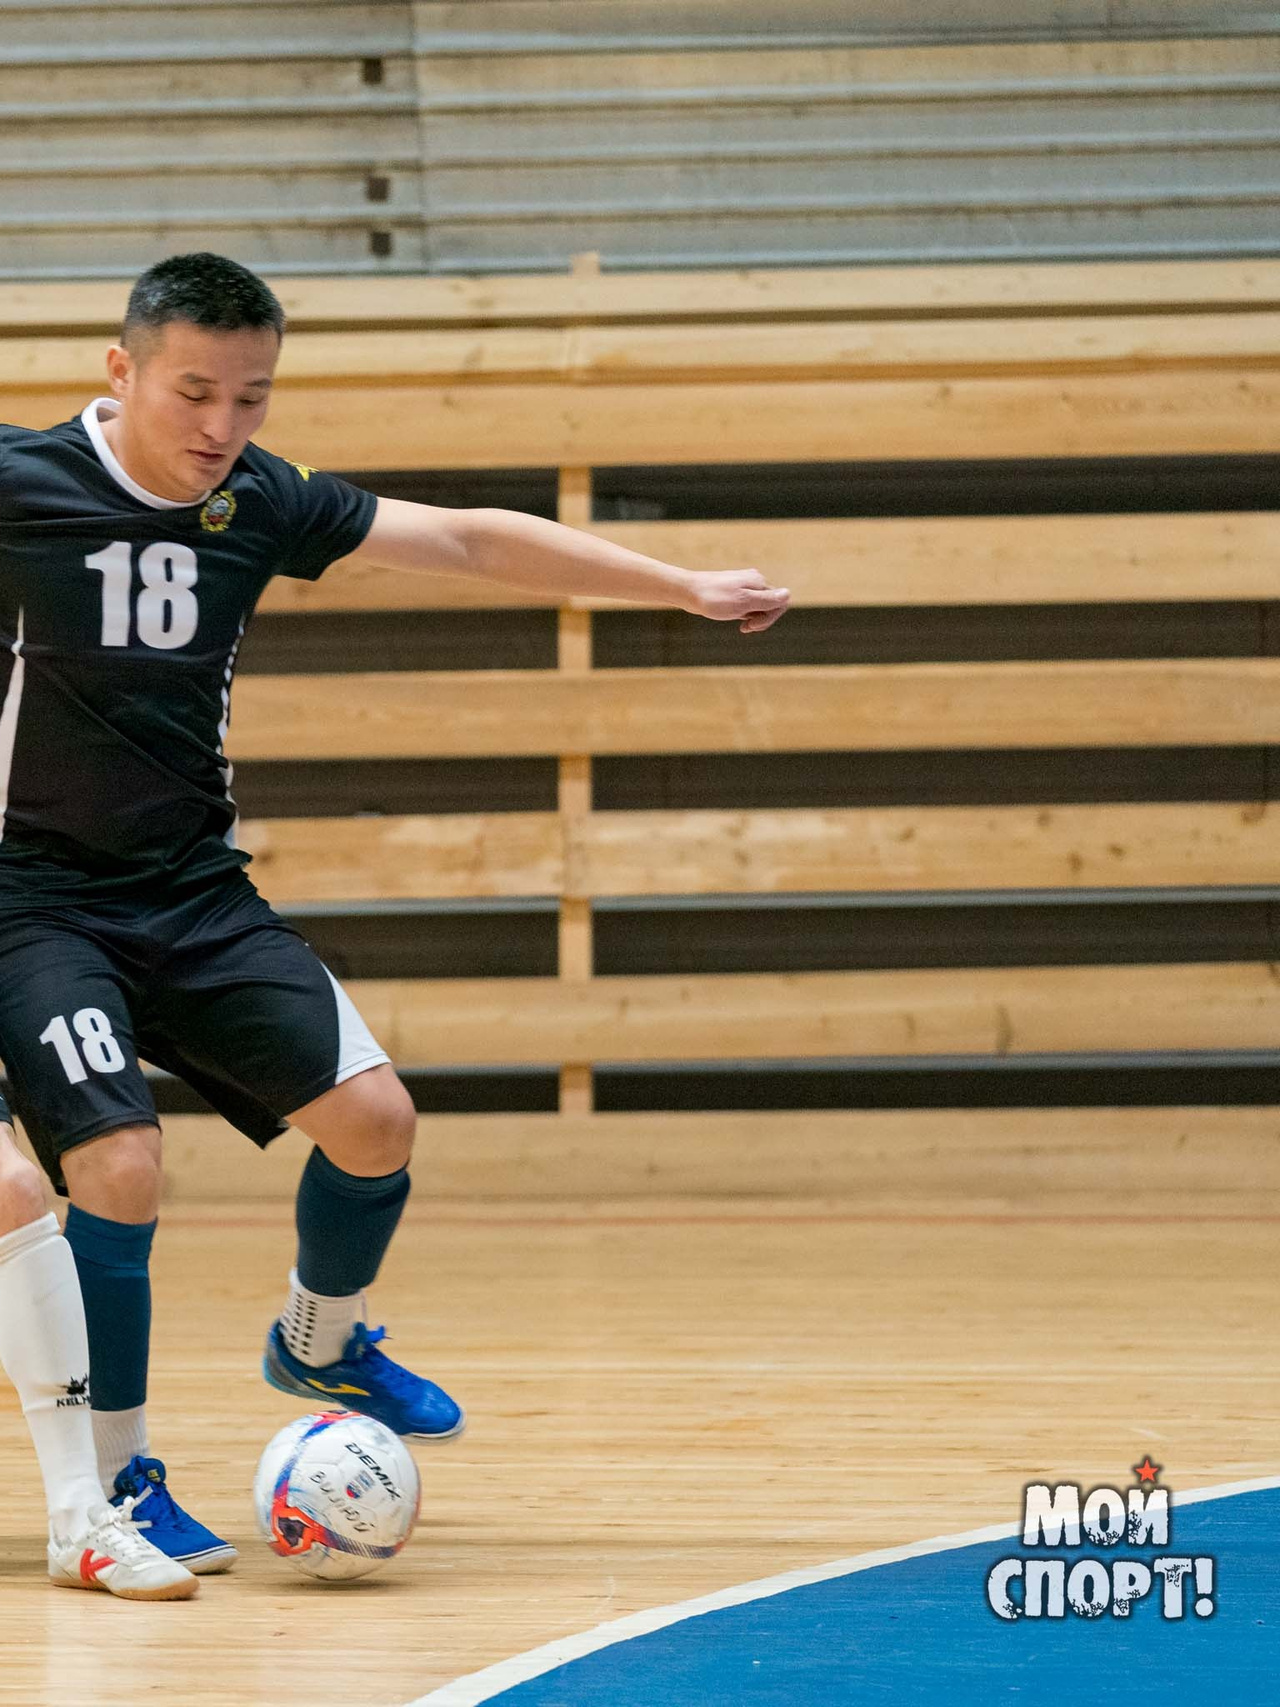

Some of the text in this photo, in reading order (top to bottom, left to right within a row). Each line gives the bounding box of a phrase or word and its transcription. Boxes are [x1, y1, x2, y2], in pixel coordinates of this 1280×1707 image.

[85, 541, 199, 650] 18
[38, 1007, 126, 1084] 18
[344, 1442, 401, 1500] DEMIX
